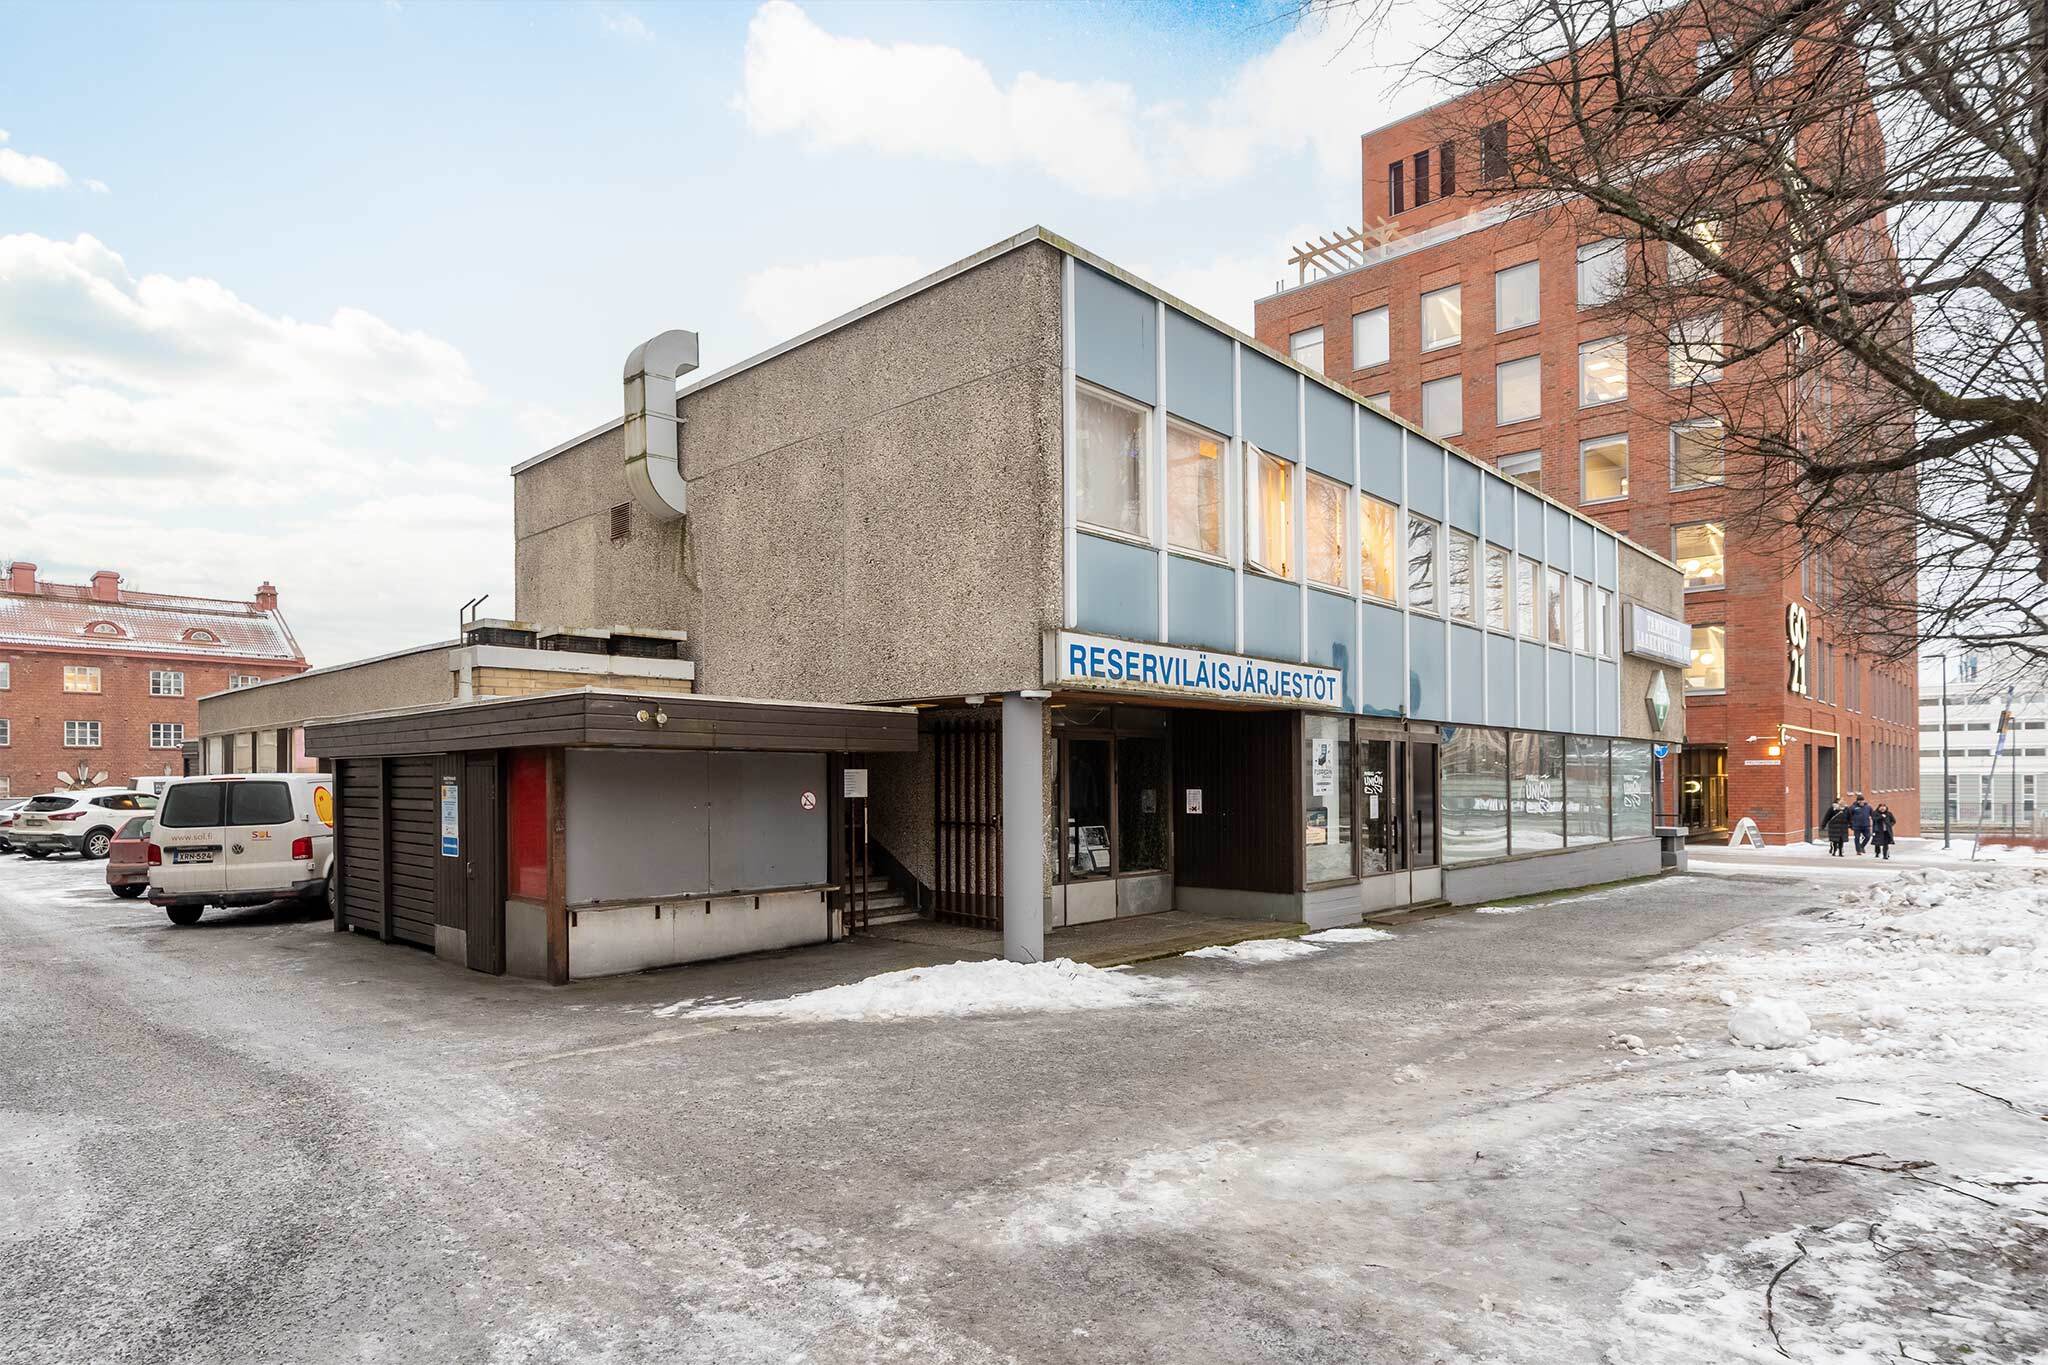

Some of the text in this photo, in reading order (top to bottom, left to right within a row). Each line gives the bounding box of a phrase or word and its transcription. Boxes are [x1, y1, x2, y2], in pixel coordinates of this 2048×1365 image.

[1069, 643, 1337, 700] RESERVILÄISJÄRJESTÖT
[251, 830, 272, 839] SOL
[179, 851, 213, 861] XRN-524
